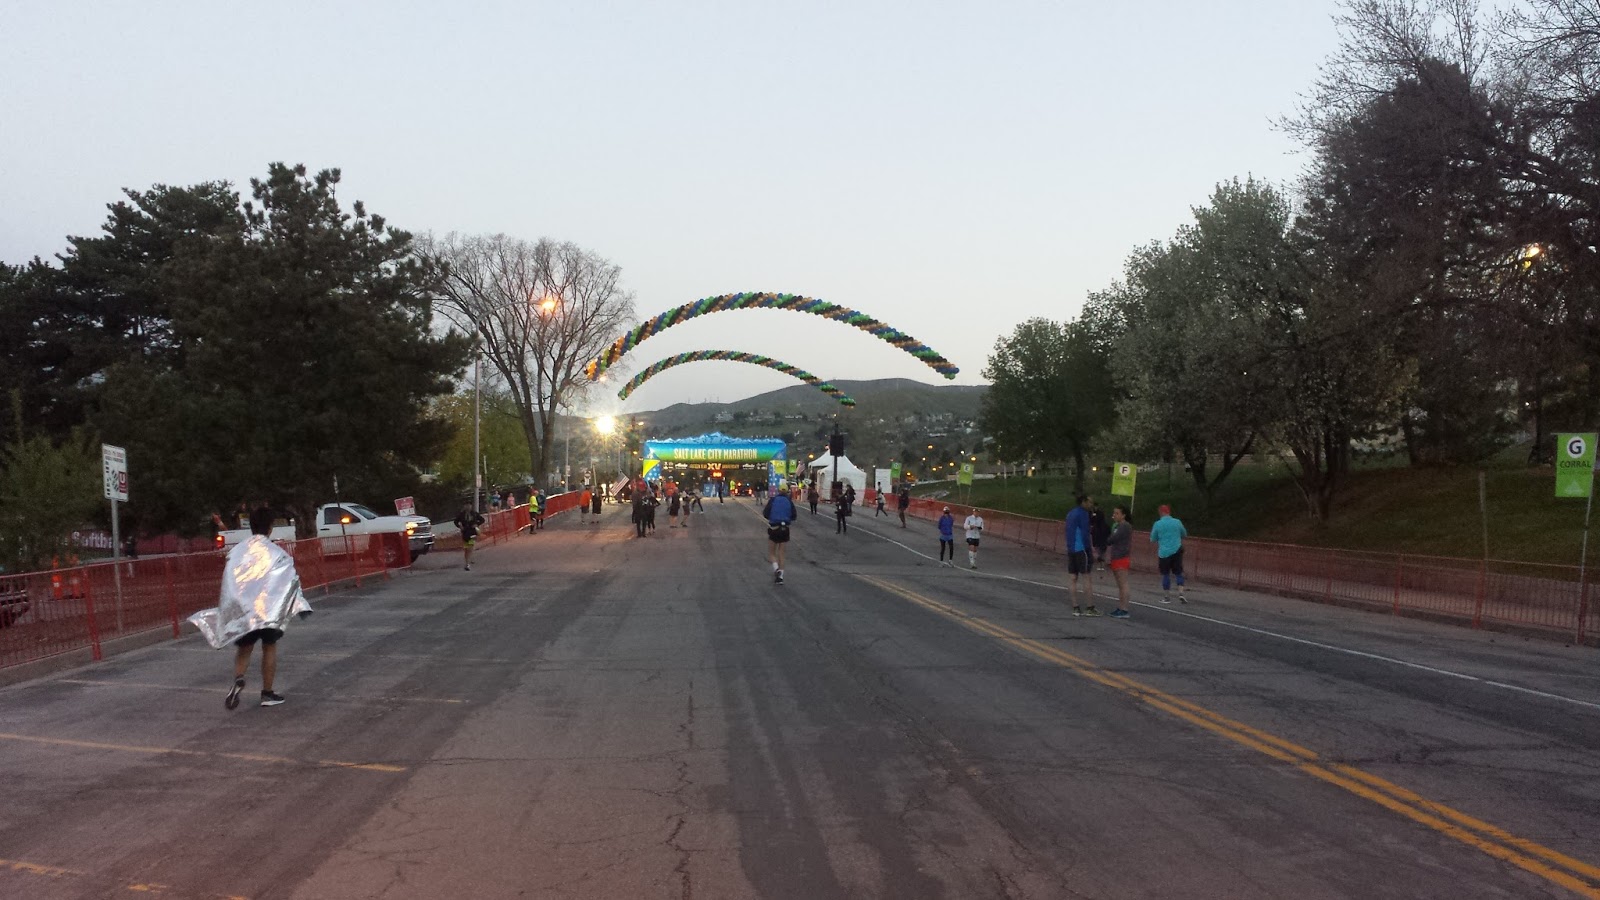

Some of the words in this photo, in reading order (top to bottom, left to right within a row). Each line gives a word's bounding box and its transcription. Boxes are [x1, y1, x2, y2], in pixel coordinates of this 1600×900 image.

[1569, 439, 1582, 454] G
[674, 448, 689, 459] SALT
[691, 448, 706, 459] LAKE
[707, 448, 722, 459] CITY
[723, 448, 757, 459] MARATHON
[1560, 460, 1591, 468] CORRAL
[1122, 466, 1128, 474] F
